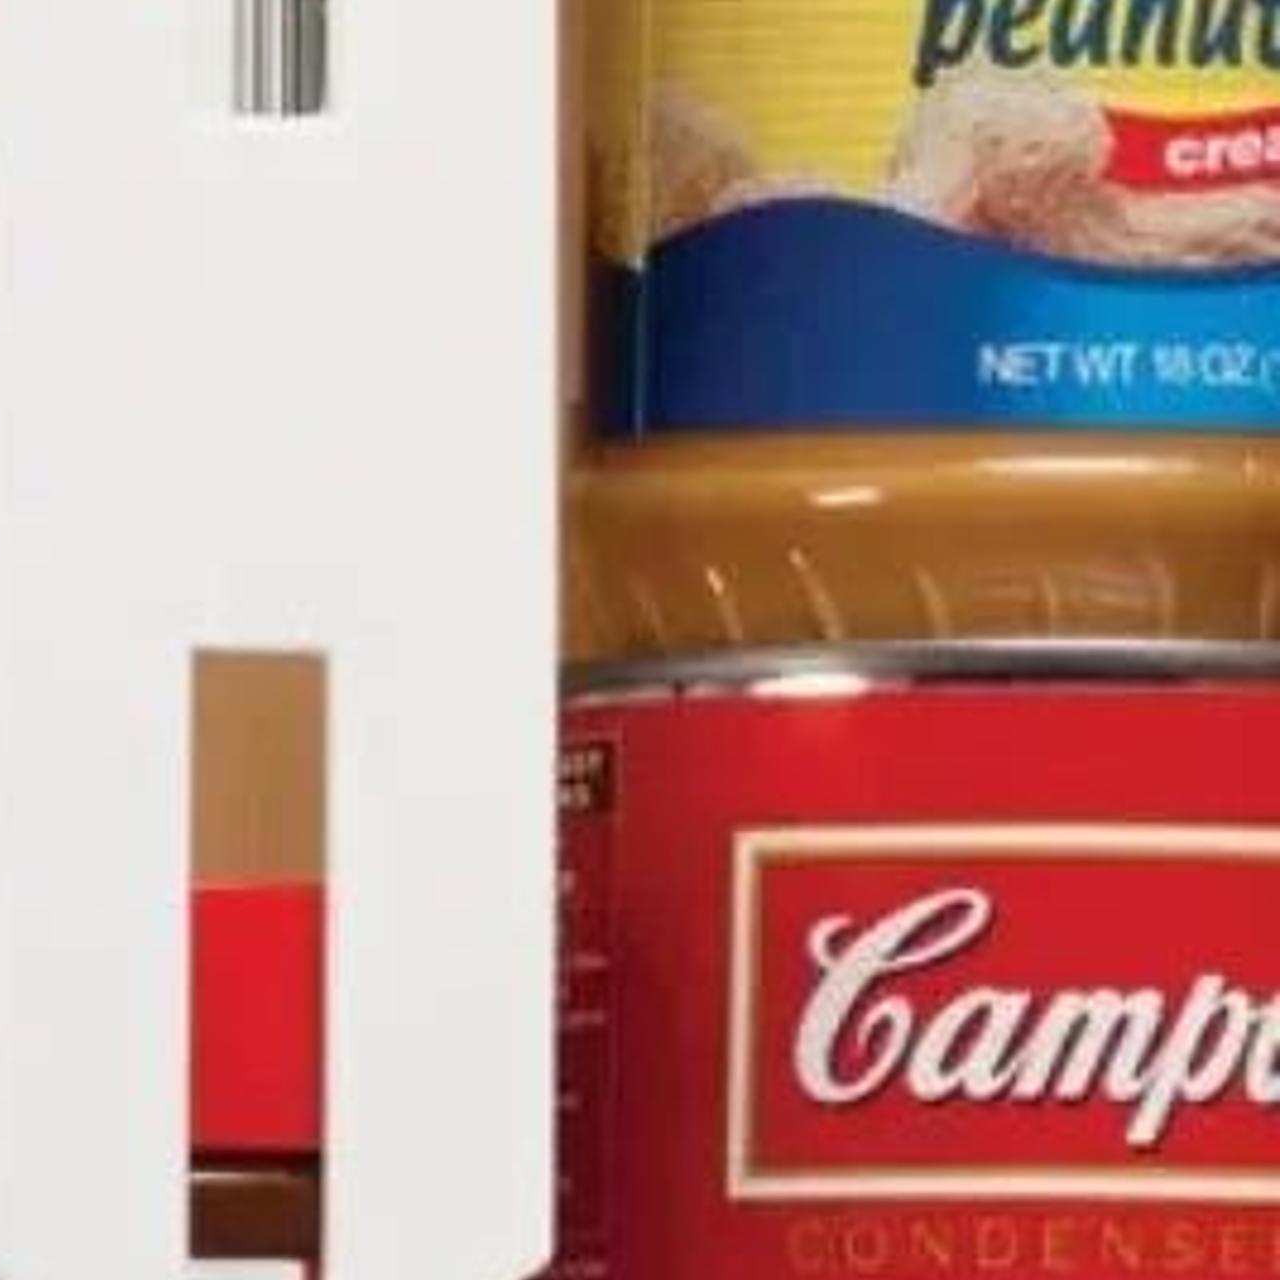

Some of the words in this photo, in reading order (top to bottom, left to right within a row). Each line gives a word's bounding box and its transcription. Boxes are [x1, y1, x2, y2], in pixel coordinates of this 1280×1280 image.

[978, 341, 1066, 387] NET
[1072, 341, 1138, 388] WT
[1200, 340, 1257, 388] OZ
[787, 1220, 1280, 1274] CONDENSE
